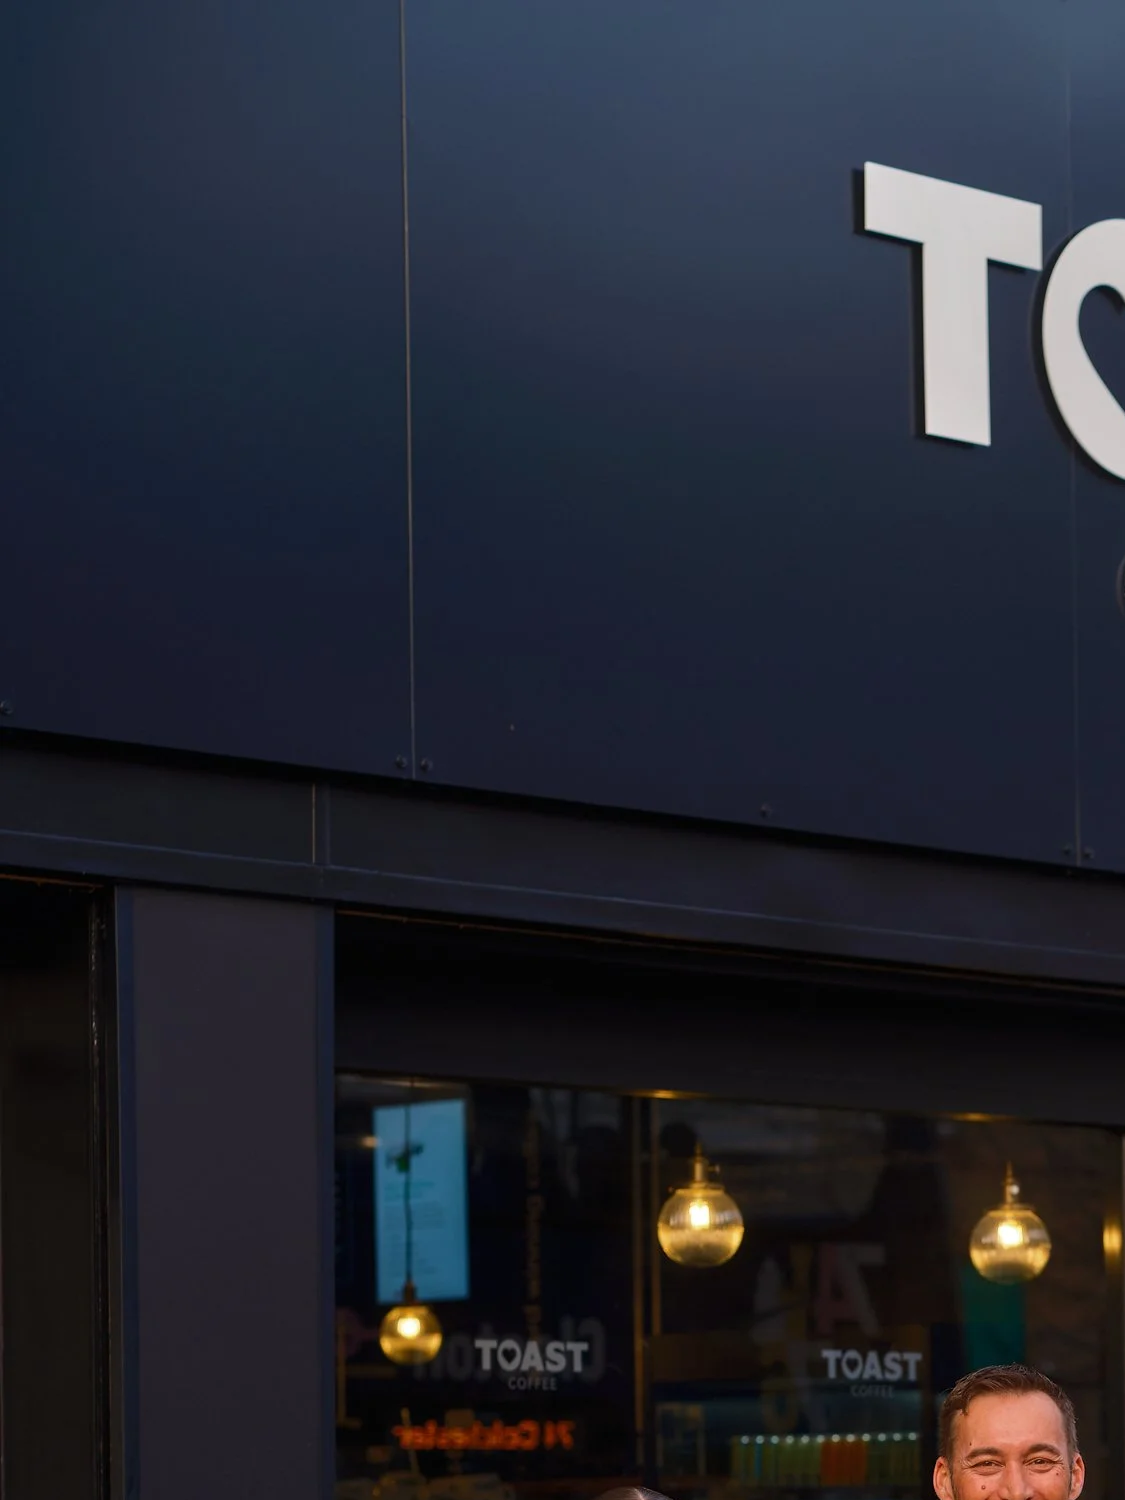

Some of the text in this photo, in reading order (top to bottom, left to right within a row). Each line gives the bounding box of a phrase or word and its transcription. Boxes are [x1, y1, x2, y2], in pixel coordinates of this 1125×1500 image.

[474, 1338, 589, 1373] TOAST
[822, 1349, 923, 1382] TOAST
[508, 1376, 557, 1391] COFFEE
